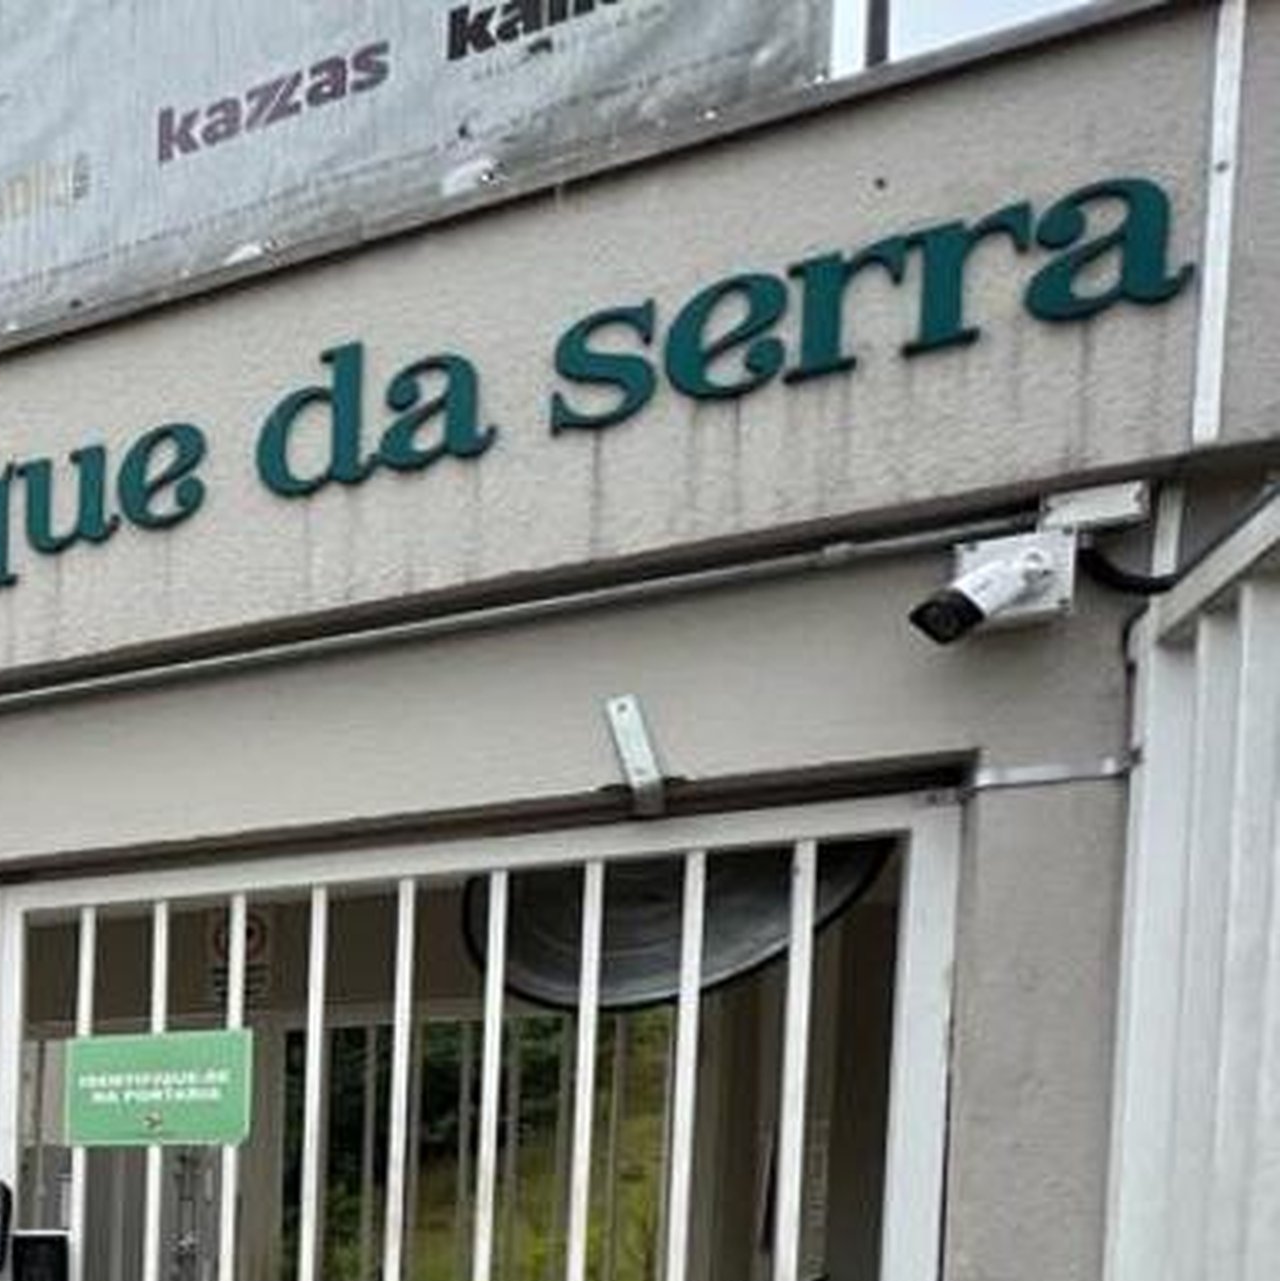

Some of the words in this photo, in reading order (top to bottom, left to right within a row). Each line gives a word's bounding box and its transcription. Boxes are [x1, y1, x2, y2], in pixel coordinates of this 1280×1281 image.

[156, 40, 391, 162] kazzas
[255, 340, 496, 498] da
[551, 175, 1196, 437] serra
